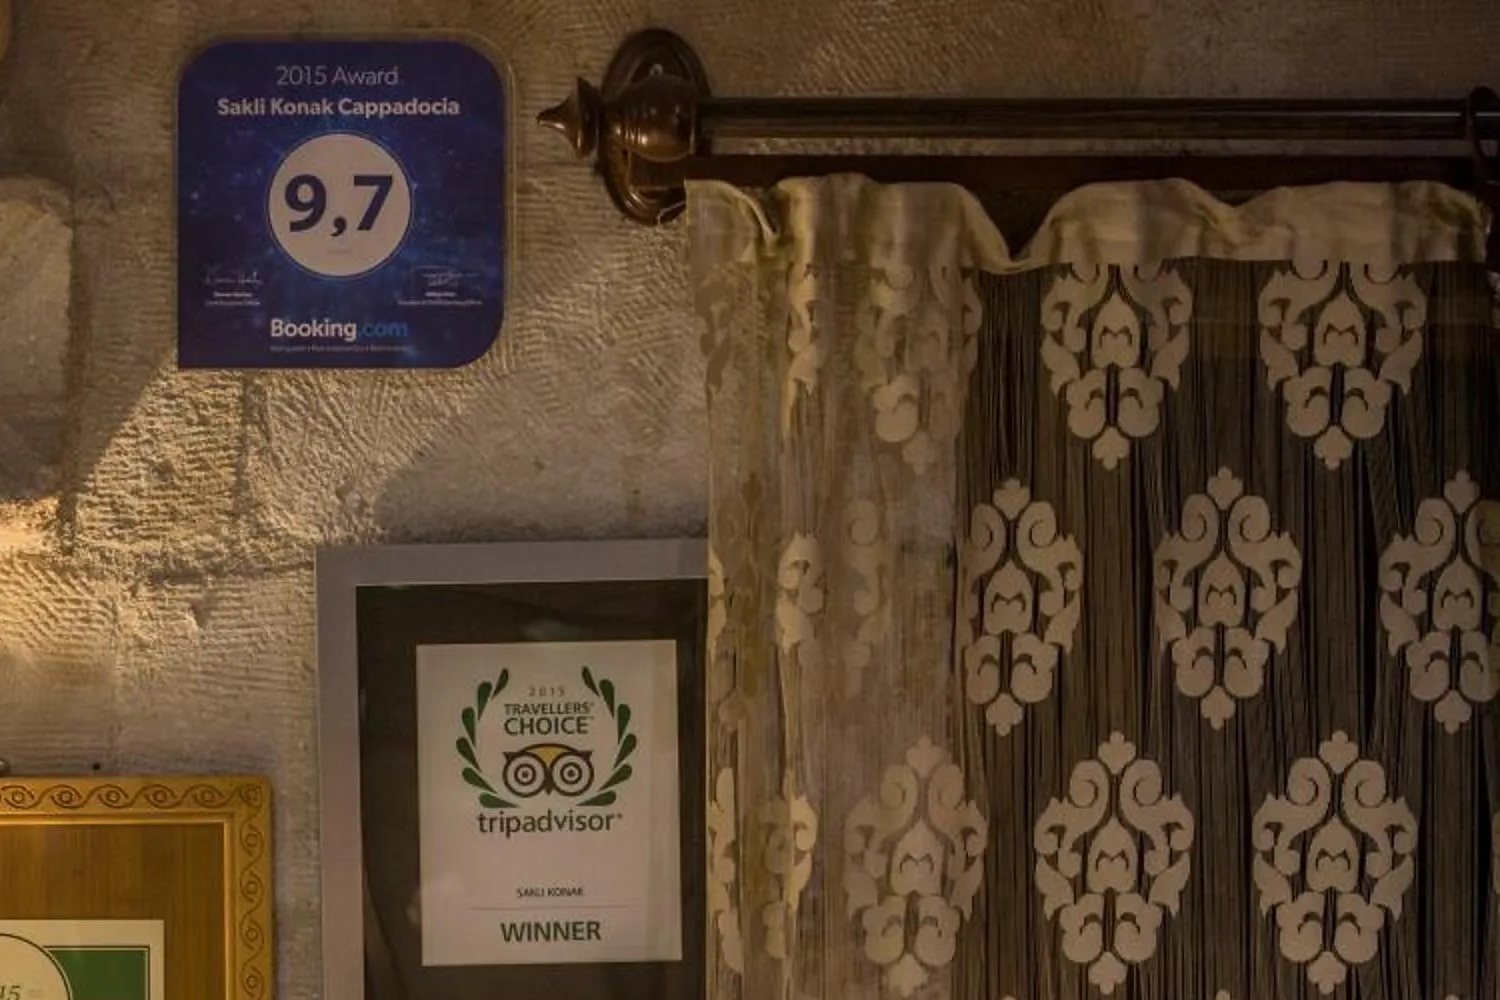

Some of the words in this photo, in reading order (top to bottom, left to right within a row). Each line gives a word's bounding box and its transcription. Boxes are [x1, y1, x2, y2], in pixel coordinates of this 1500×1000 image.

[276, 66, 327, 85] 2015
[331, 66, 399, 86] Award
[217, 98, 265, 116] Sakli
[270, 98, 334, 116] Konak
[338, 97, 460, 119] Cappadocia
[284, 173, 393, 237] 9,7
[270, 318, 409, 341] Booking.com
[503, 716, 589, 736] CHOICE
[476, 809, 615, 839] tripadvisor
[501, 921, 602, 943] WINNER
